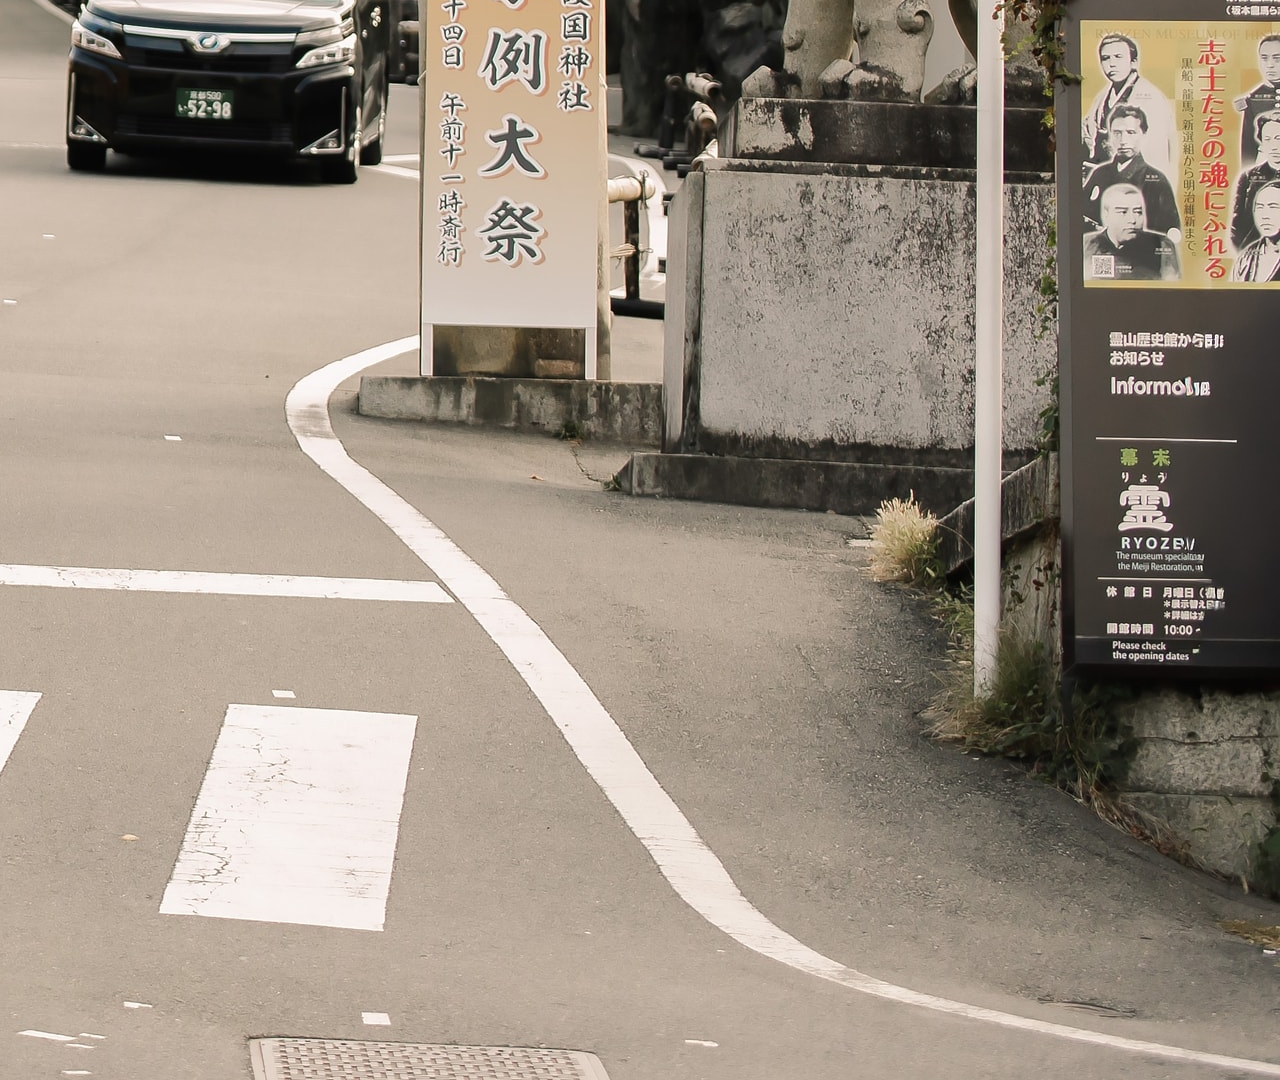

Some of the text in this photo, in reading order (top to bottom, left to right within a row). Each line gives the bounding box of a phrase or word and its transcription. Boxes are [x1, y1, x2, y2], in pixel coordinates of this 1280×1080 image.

[187, 99, 232, 119] 52-98
[1198, 39, 1229, 280] 志士たちの魂にふれる
[1109, 350, 1165, 366] お知らせ
[1121, 448, 1171, 466] 幕末
[1121, 471, 1167, 483] りょう
[1118, 484, 1174, 532] 霊
[1116, 551, 1130, 561] The
[1131, 552, 1163, 561] museum
[1118, 562, 1131, 571] the
[1131, 562, 1150, 572] Meiji
[1151, 563, 1194, 572] Restoration,
[1107, 623, 1193, 635] 開館時間 10:00
[1112, 641, 1167, 651] Please check
[1112, 651, 1190, 662] the opening dates
